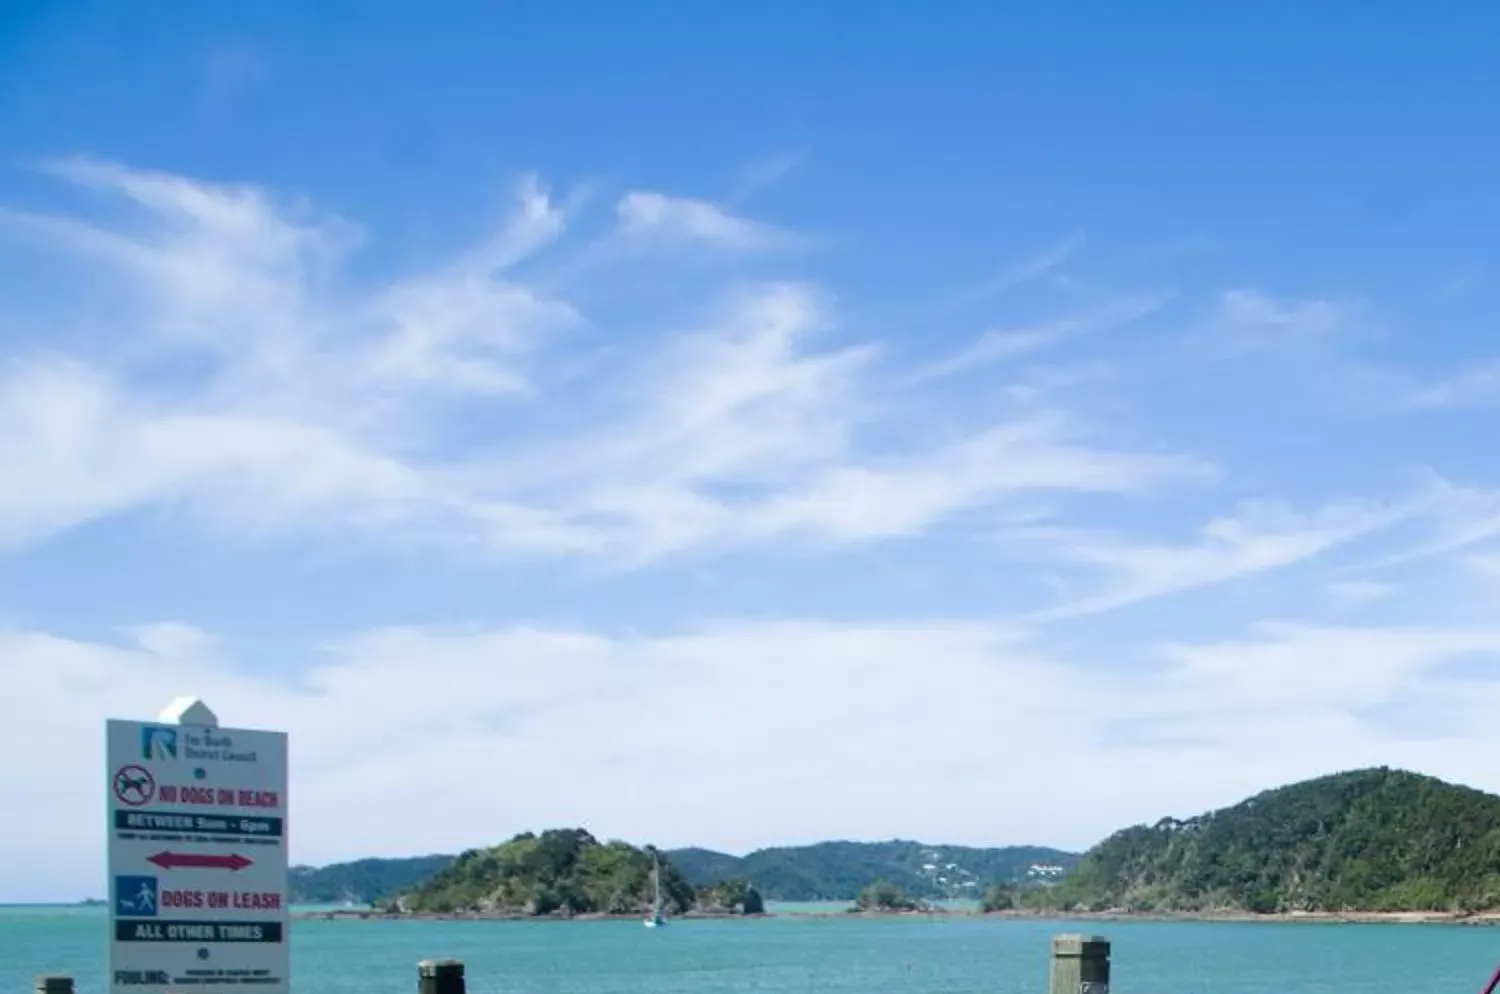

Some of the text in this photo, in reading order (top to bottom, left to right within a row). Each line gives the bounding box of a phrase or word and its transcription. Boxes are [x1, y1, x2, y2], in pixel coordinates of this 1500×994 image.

[159, 785, 278, 808] NO DOGS ON BEACH
[127, 812, 193, 830] BETWEEN
[161, 889, 281, 910] DOGS ON LEASH
[135, 924, 263, 940] ALL OTHER TIMES
